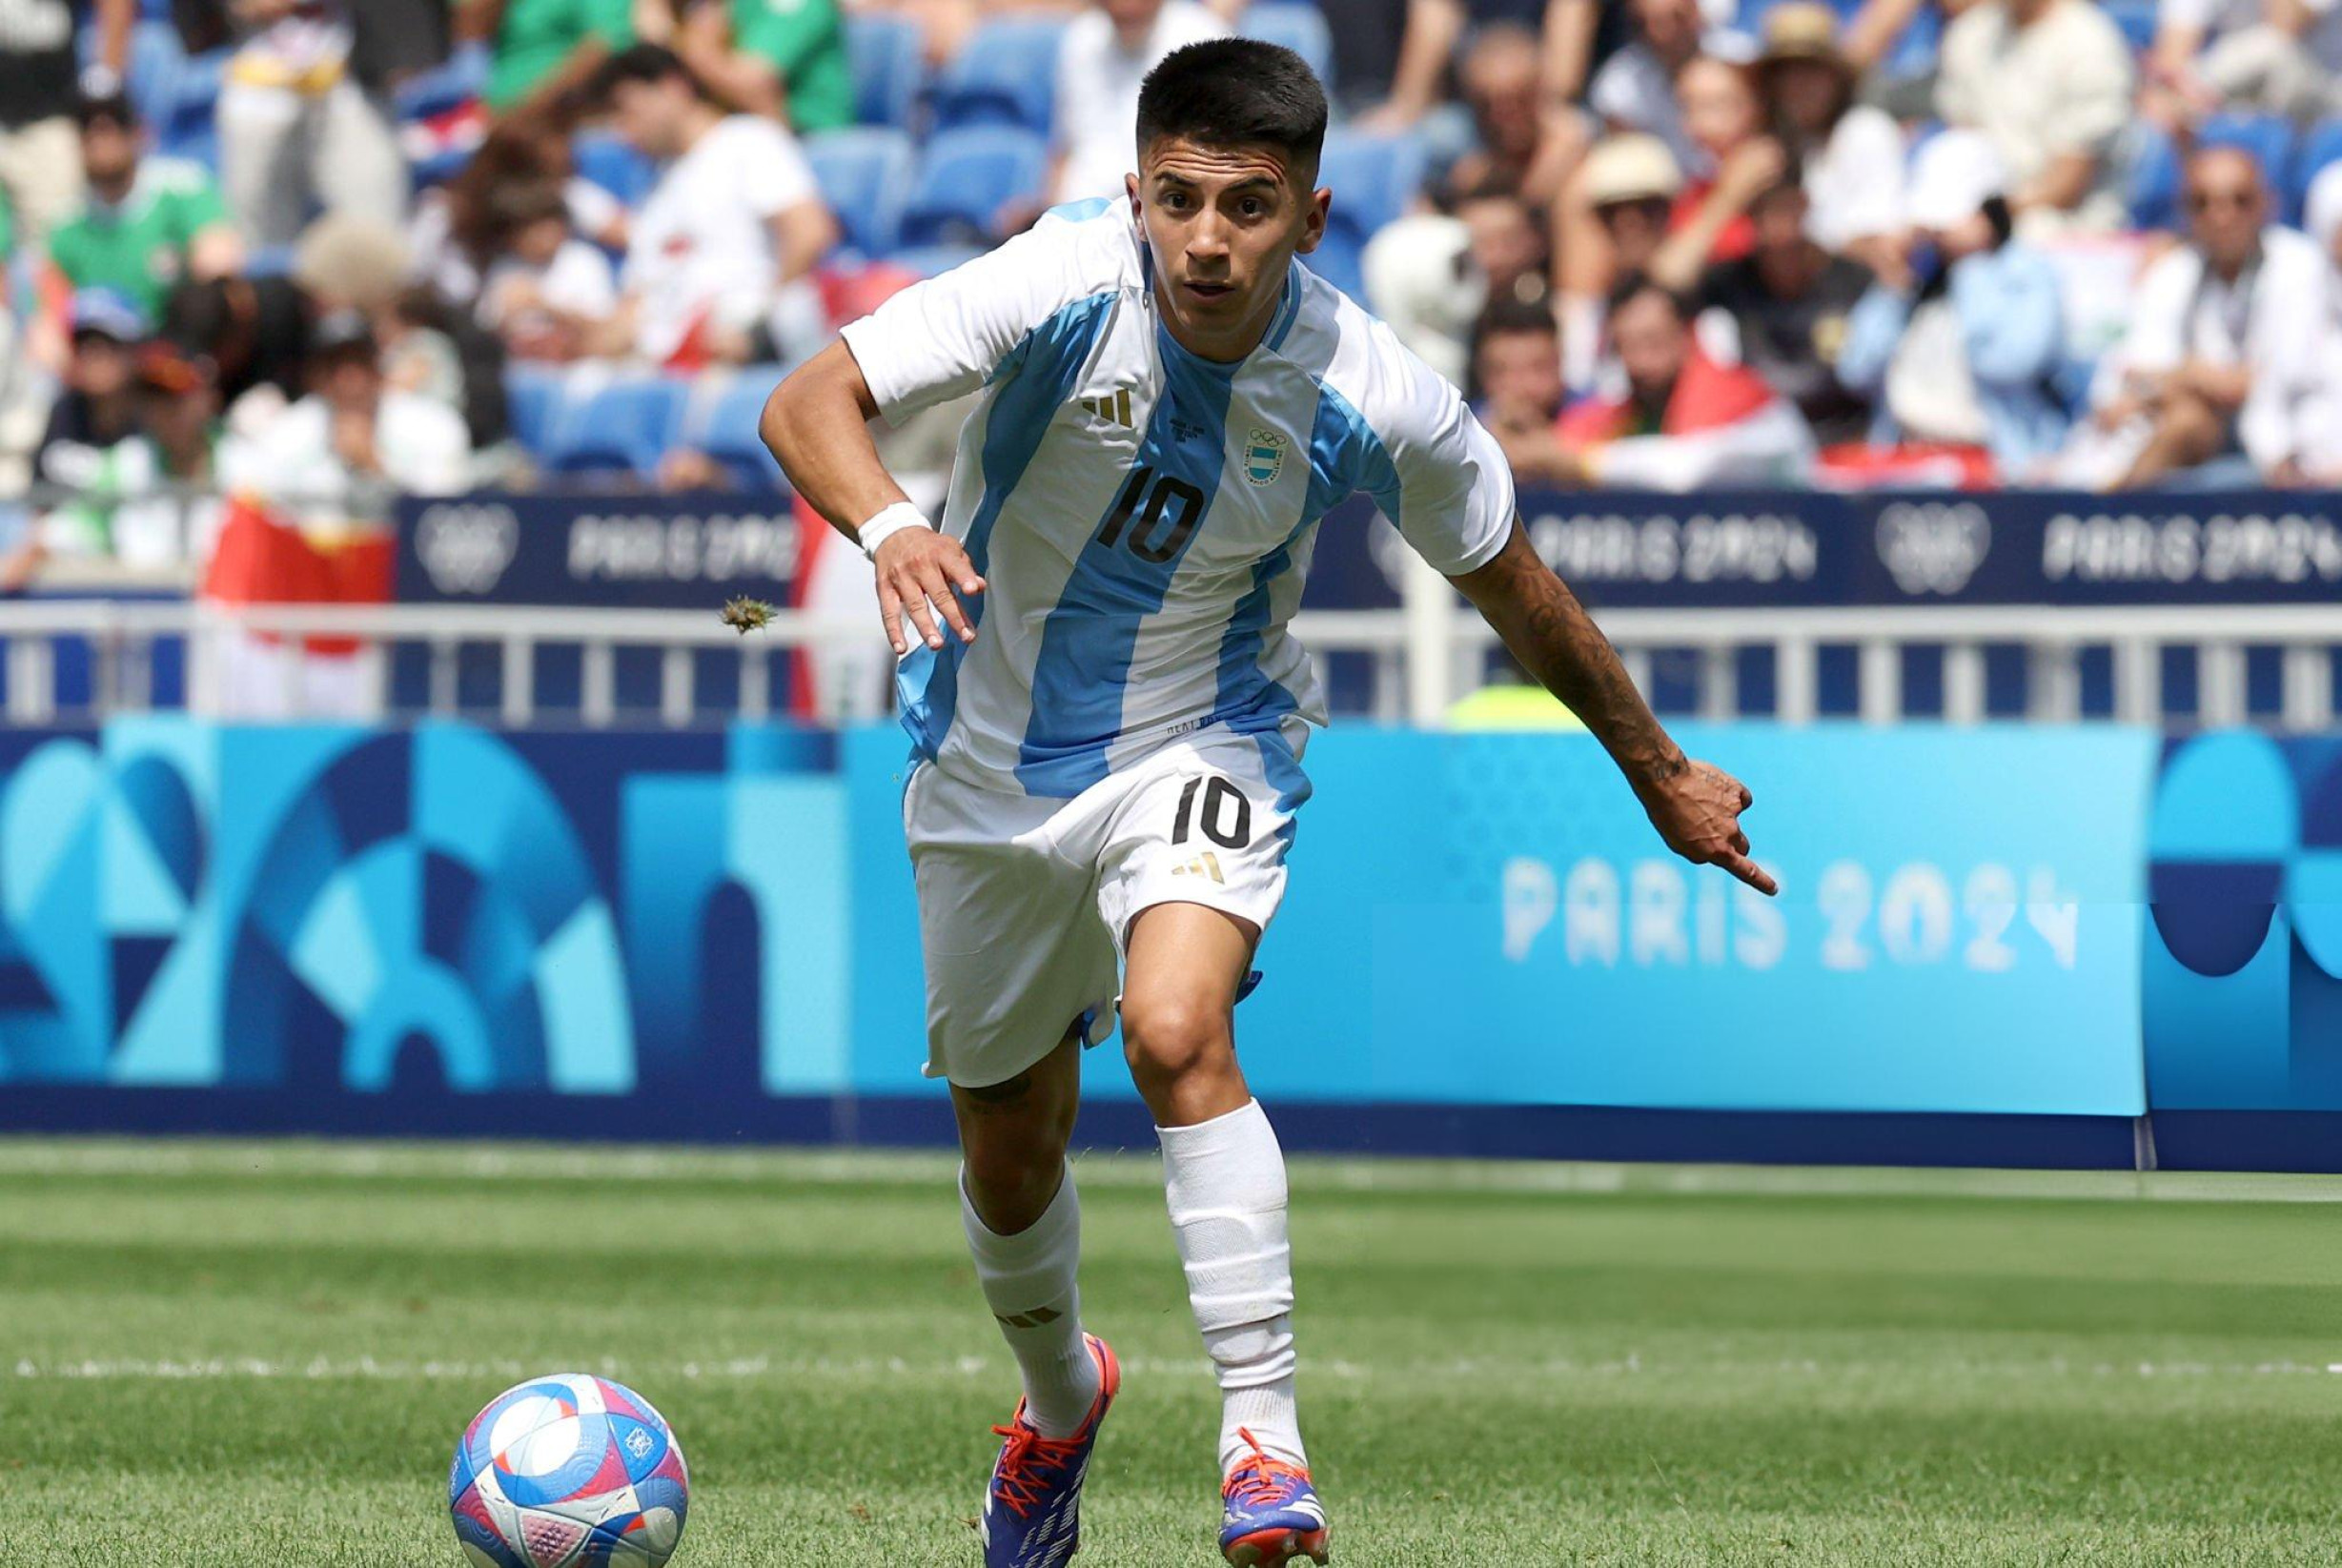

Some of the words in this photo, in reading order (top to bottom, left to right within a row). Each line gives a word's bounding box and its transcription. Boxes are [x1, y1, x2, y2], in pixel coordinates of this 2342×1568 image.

[1097, 466, 1204, 564] 10
[1171, 776, 1251, 849] 10
[1502, 857, 1788, 971] PARIS
[1817, 859, 2078, 973] 2024
